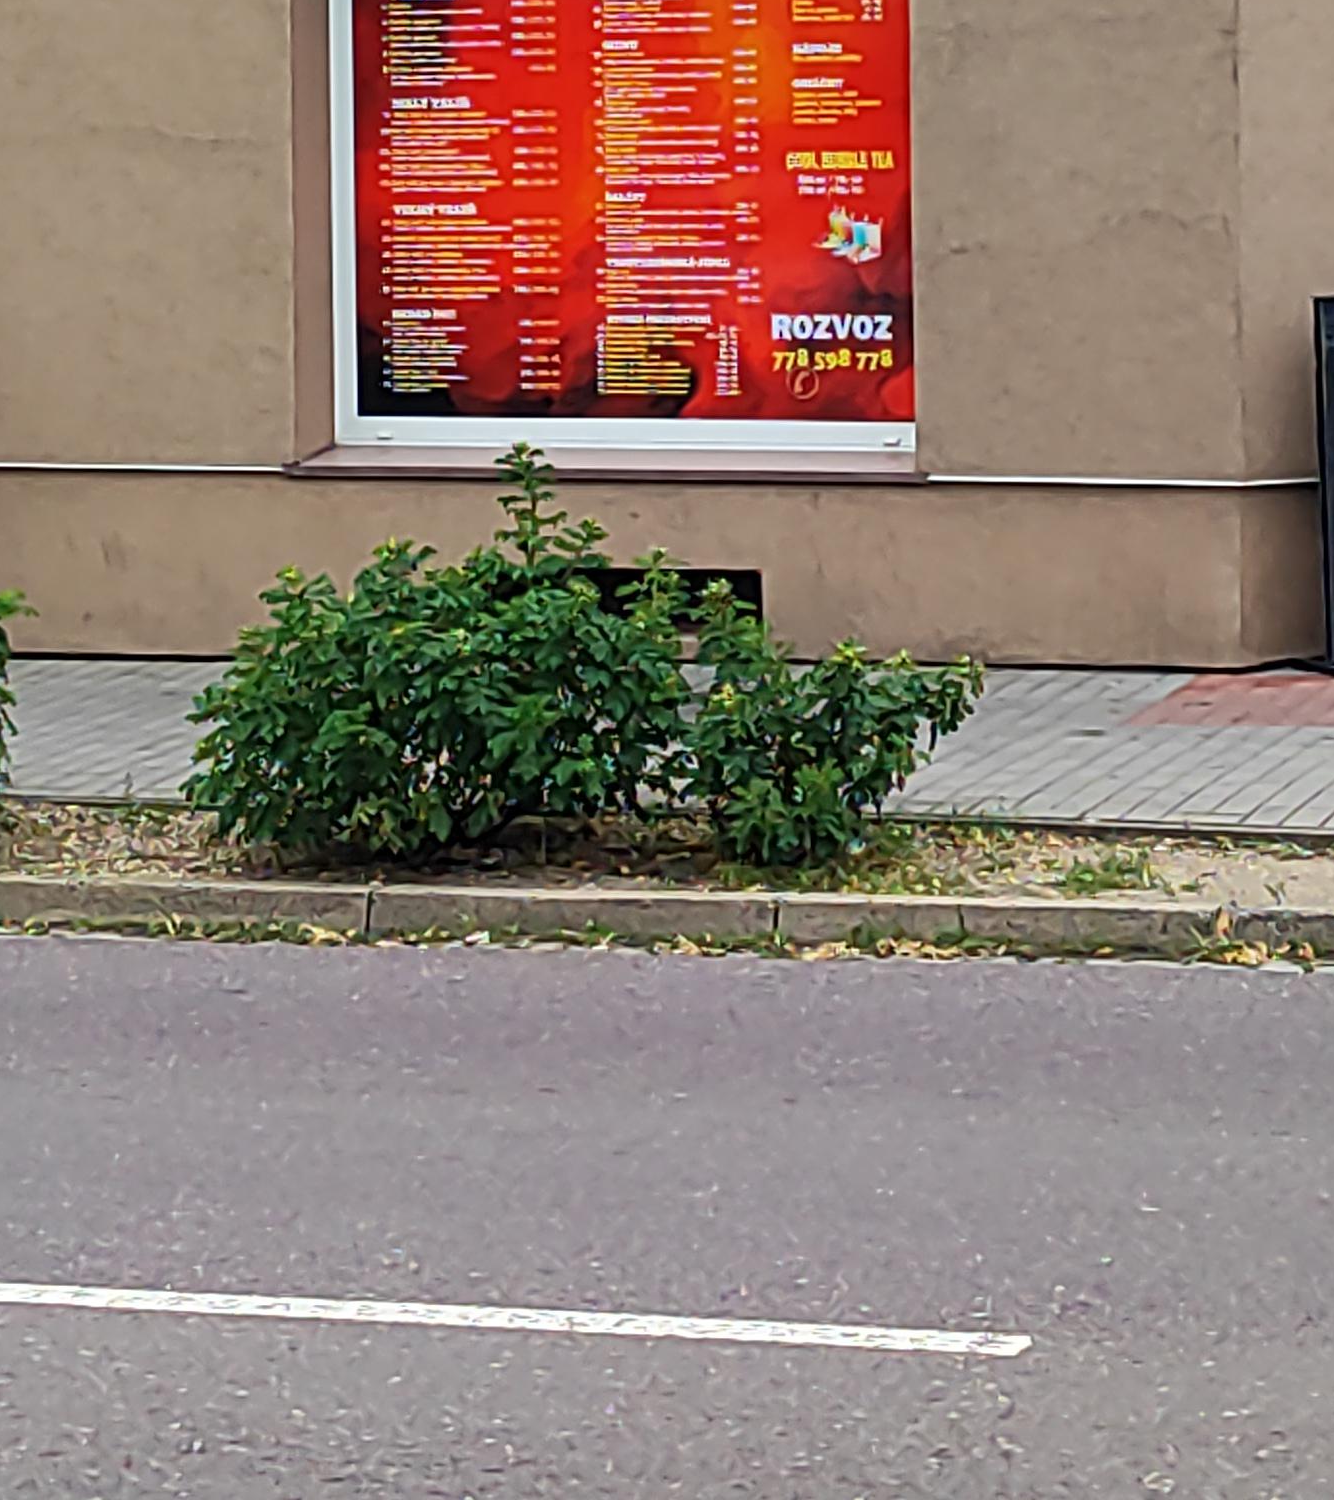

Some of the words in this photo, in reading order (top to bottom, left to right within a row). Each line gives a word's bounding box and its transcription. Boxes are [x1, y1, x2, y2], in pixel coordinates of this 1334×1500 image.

[771, 313, 893, 341] ROZVOZ
[772, 349, 809, 372] 778
[814, 349, 851, 371] 598
[856, 349, 893, 371] 778
